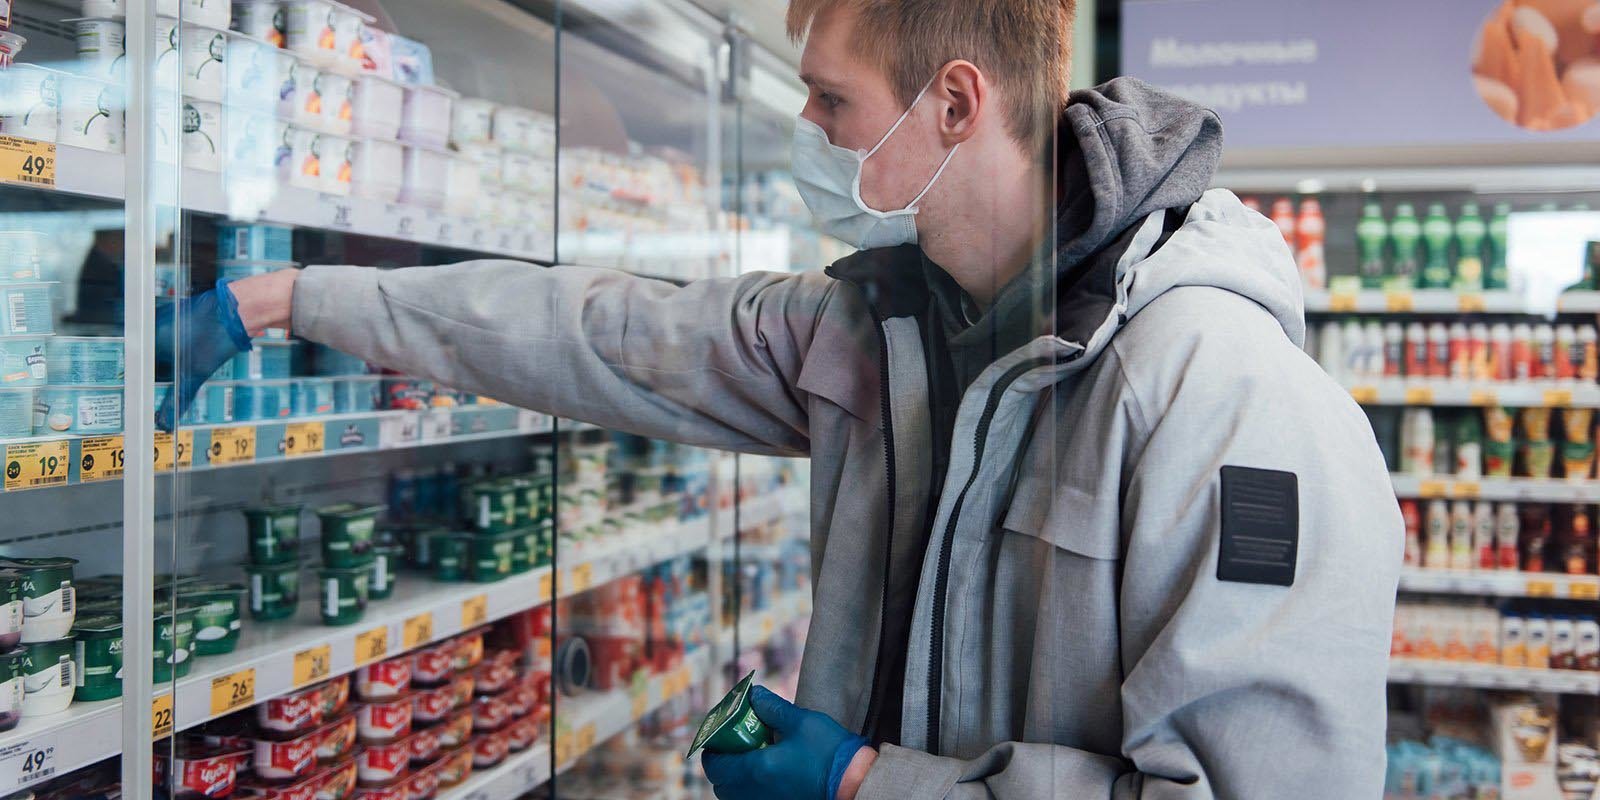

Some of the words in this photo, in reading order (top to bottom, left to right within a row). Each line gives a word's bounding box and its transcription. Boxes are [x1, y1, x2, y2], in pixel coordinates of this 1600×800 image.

[22, 155, 45, 175] 49
[235, 439, 248, 456] 19
[39, 456, 58, 476] 19
[231, 680, 247, 699] 26
[155, 708, 171, 729] 22
[22, 750, 45, 773] 49
